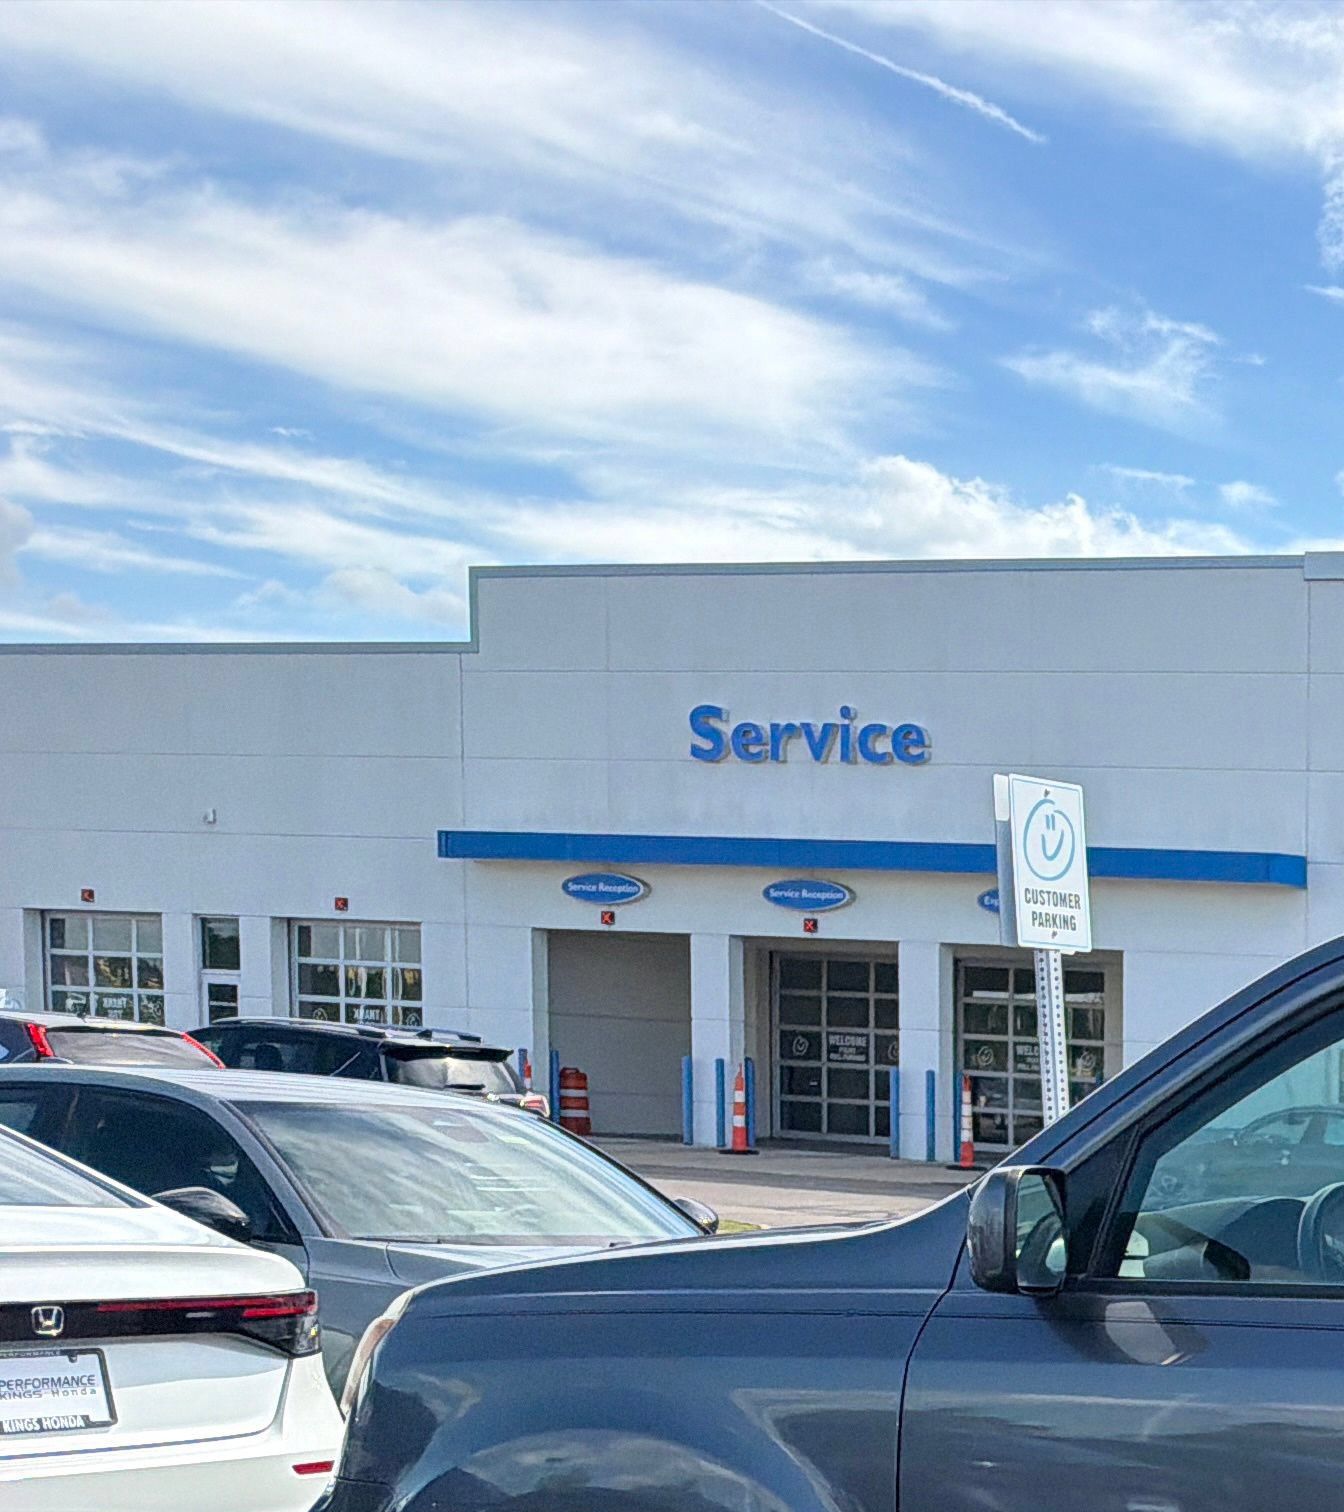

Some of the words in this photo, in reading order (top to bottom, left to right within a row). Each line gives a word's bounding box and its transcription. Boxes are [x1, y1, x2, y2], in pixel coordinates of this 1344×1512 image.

[689, 704, 931, 765] Service
[567, 882, 597, 892] Service
[598, 882, 639, 894] Reception
[769, 887, 799, 898] Service
[801, 887, 844, 900] Reception
[1024, 887, 1081, 910] CUSTOMER
[1031, 911, 1077, 931] PARKING
[1015, 1045, 1039, 1056] WELC
[0, 1375, 96, 1392] PERFORMANCE
[0, 1390, 42, 1400] KINGS
[51, 1387, 97, 1398] Honda
[2, 1418, 41, 1433] KINGS
[42, 1415, 86, 1430] HONDA
